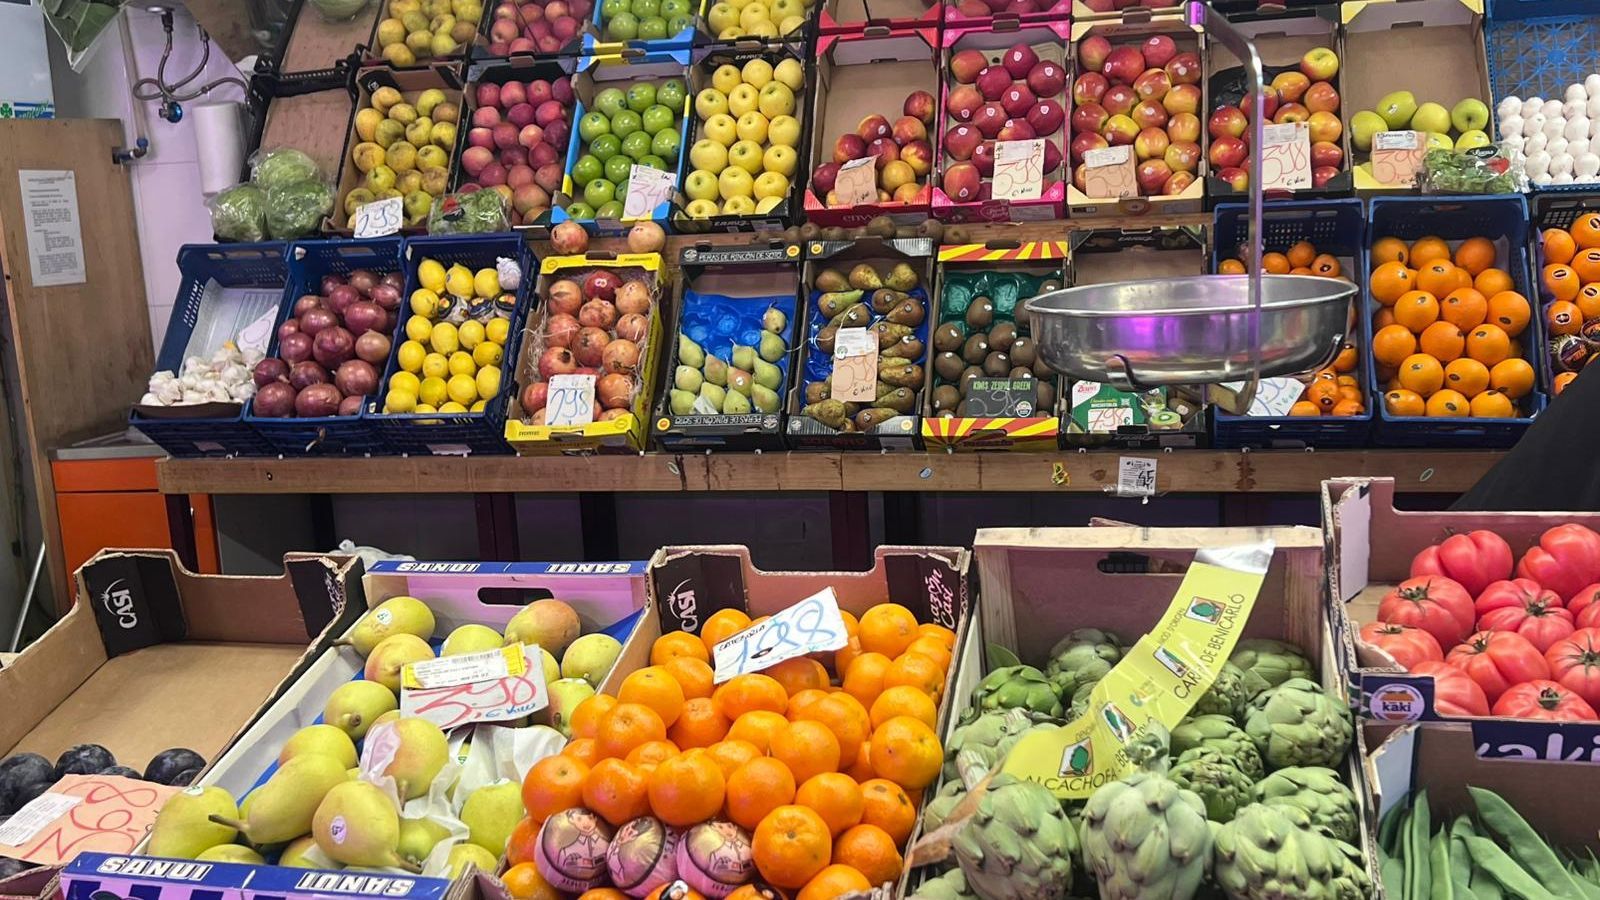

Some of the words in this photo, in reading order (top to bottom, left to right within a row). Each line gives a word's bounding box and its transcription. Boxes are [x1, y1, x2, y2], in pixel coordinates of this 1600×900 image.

[396, 562, 480, 573] SANUI
[544, 562, 632, 573] SANUI
[111, 589, 138, 629] CASI
[677, 590, 699, 632] CASI
[940, 584, 956, 630] Casi
[1199, 649, 1217, 664] DE
[1210, 593, 1246, 651] BENICARLÓ
[1382, 701, 1412, 712] kaki
[97, 857, 213, 880] SANUI
[295, 872, 415, 896] SANUI
